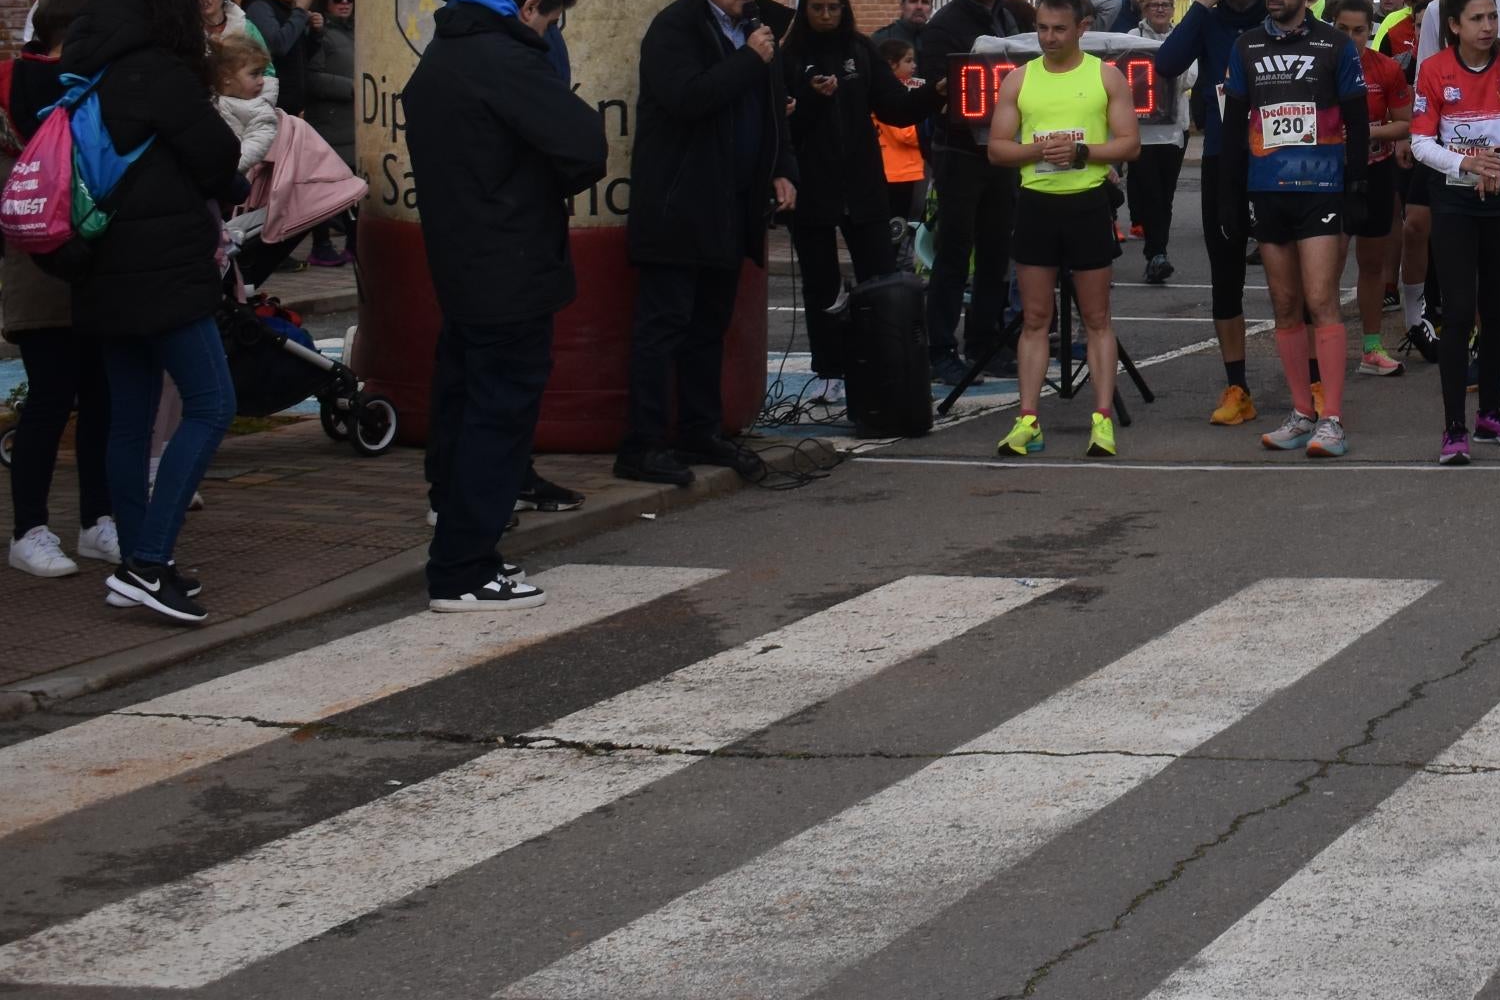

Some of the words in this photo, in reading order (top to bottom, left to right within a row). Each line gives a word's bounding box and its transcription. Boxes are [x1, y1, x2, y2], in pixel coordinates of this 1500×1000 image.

[1262, 104, 1315, 120] bedunia
[1272, 117, 1304, 136] 230
[1451, 123, 1491, 146] Simón
